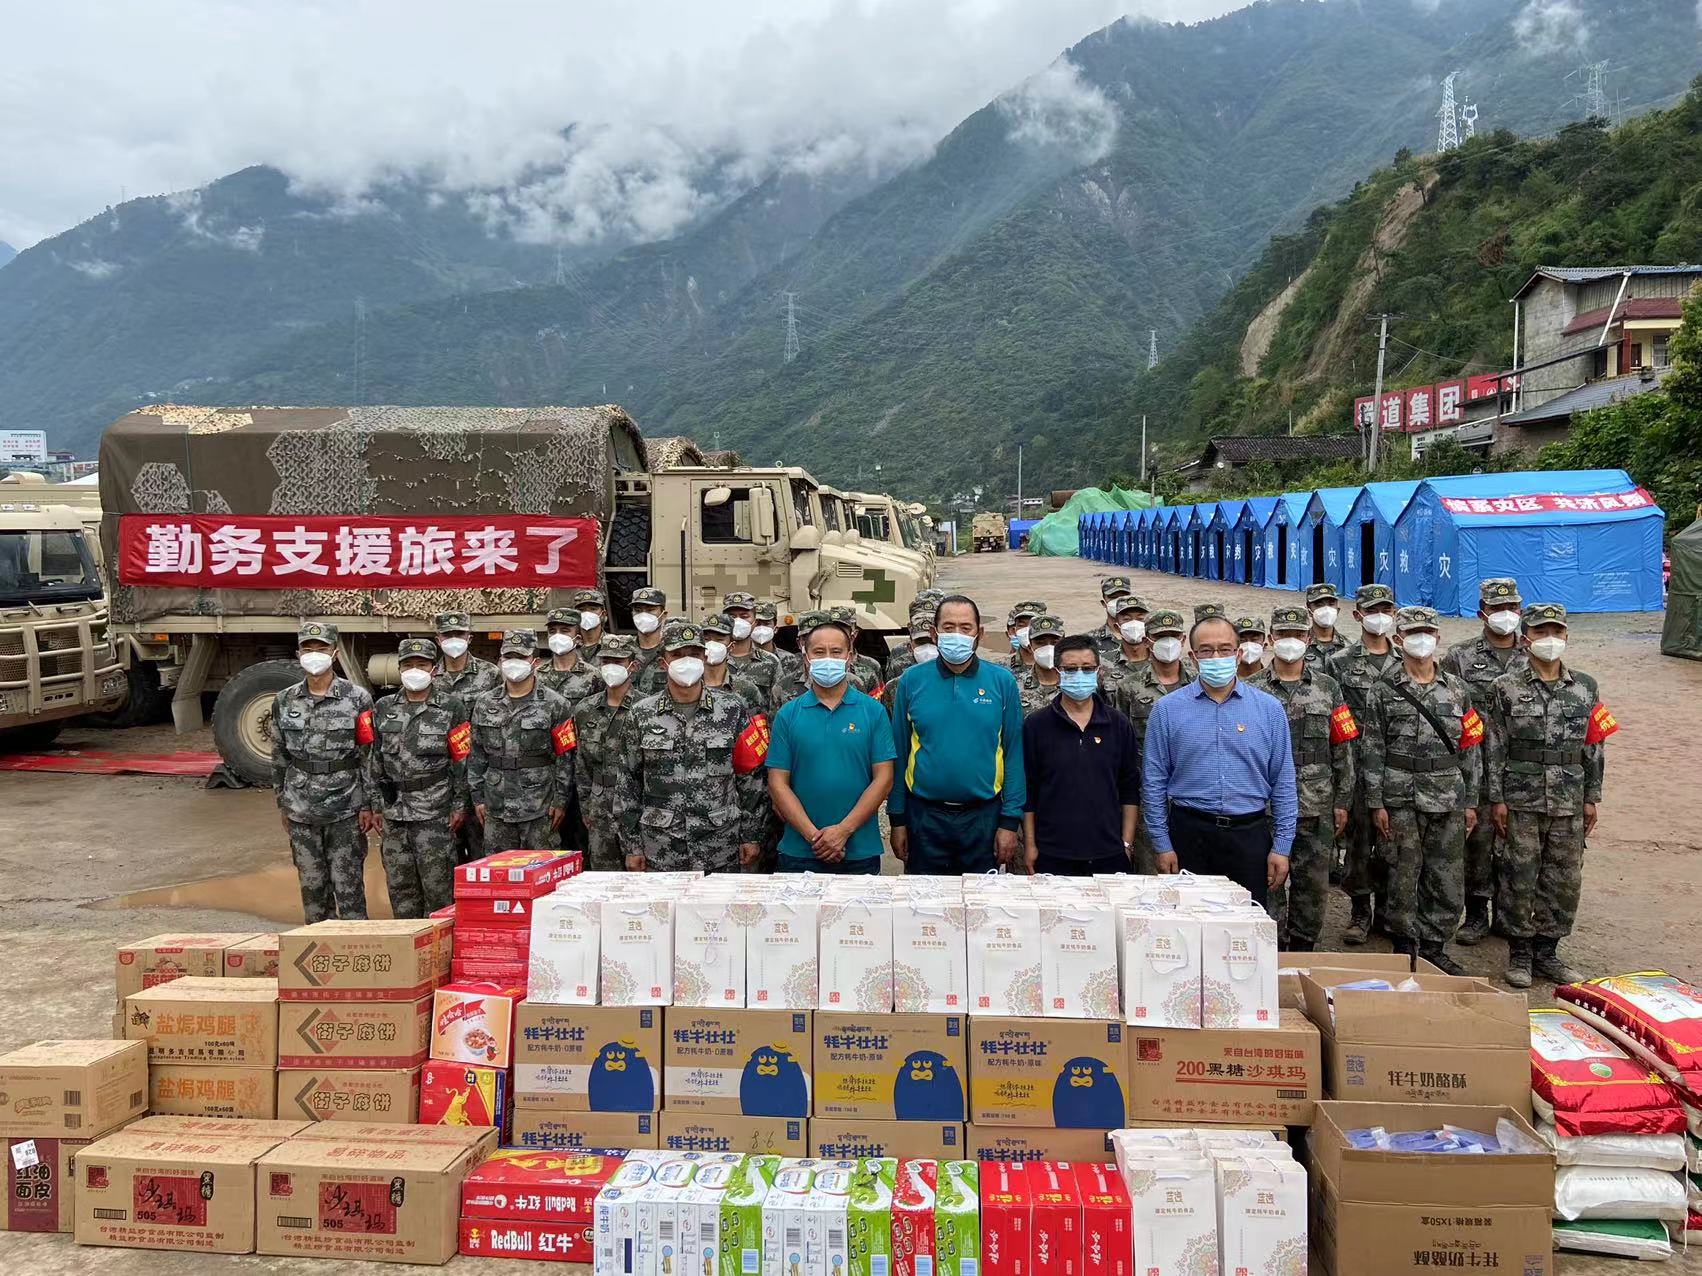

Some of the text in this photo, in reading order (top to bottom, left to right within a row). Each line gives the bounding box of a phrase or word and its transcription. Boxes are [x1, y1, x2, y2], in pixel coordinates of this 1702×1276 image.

[145, 524, 579, 577] 勤务支援旅来了
[1439, 553, 1451, 579] 灾
[155, 1013, 236, 1036] 盐焗鸡腿
[157, 1077, 235, 1100] 盐焗鸡腿
[1388, 1070, 1467, 1089] 牦牛奶酪酥
[137, 1210, 157, 1221] 505
[323, 1218, 344, 1229] 505
[490, 1229, 574, 1253] RedBull 红牛
[1413, 1250, 1499, 1268] 牦牛奶酪酥
